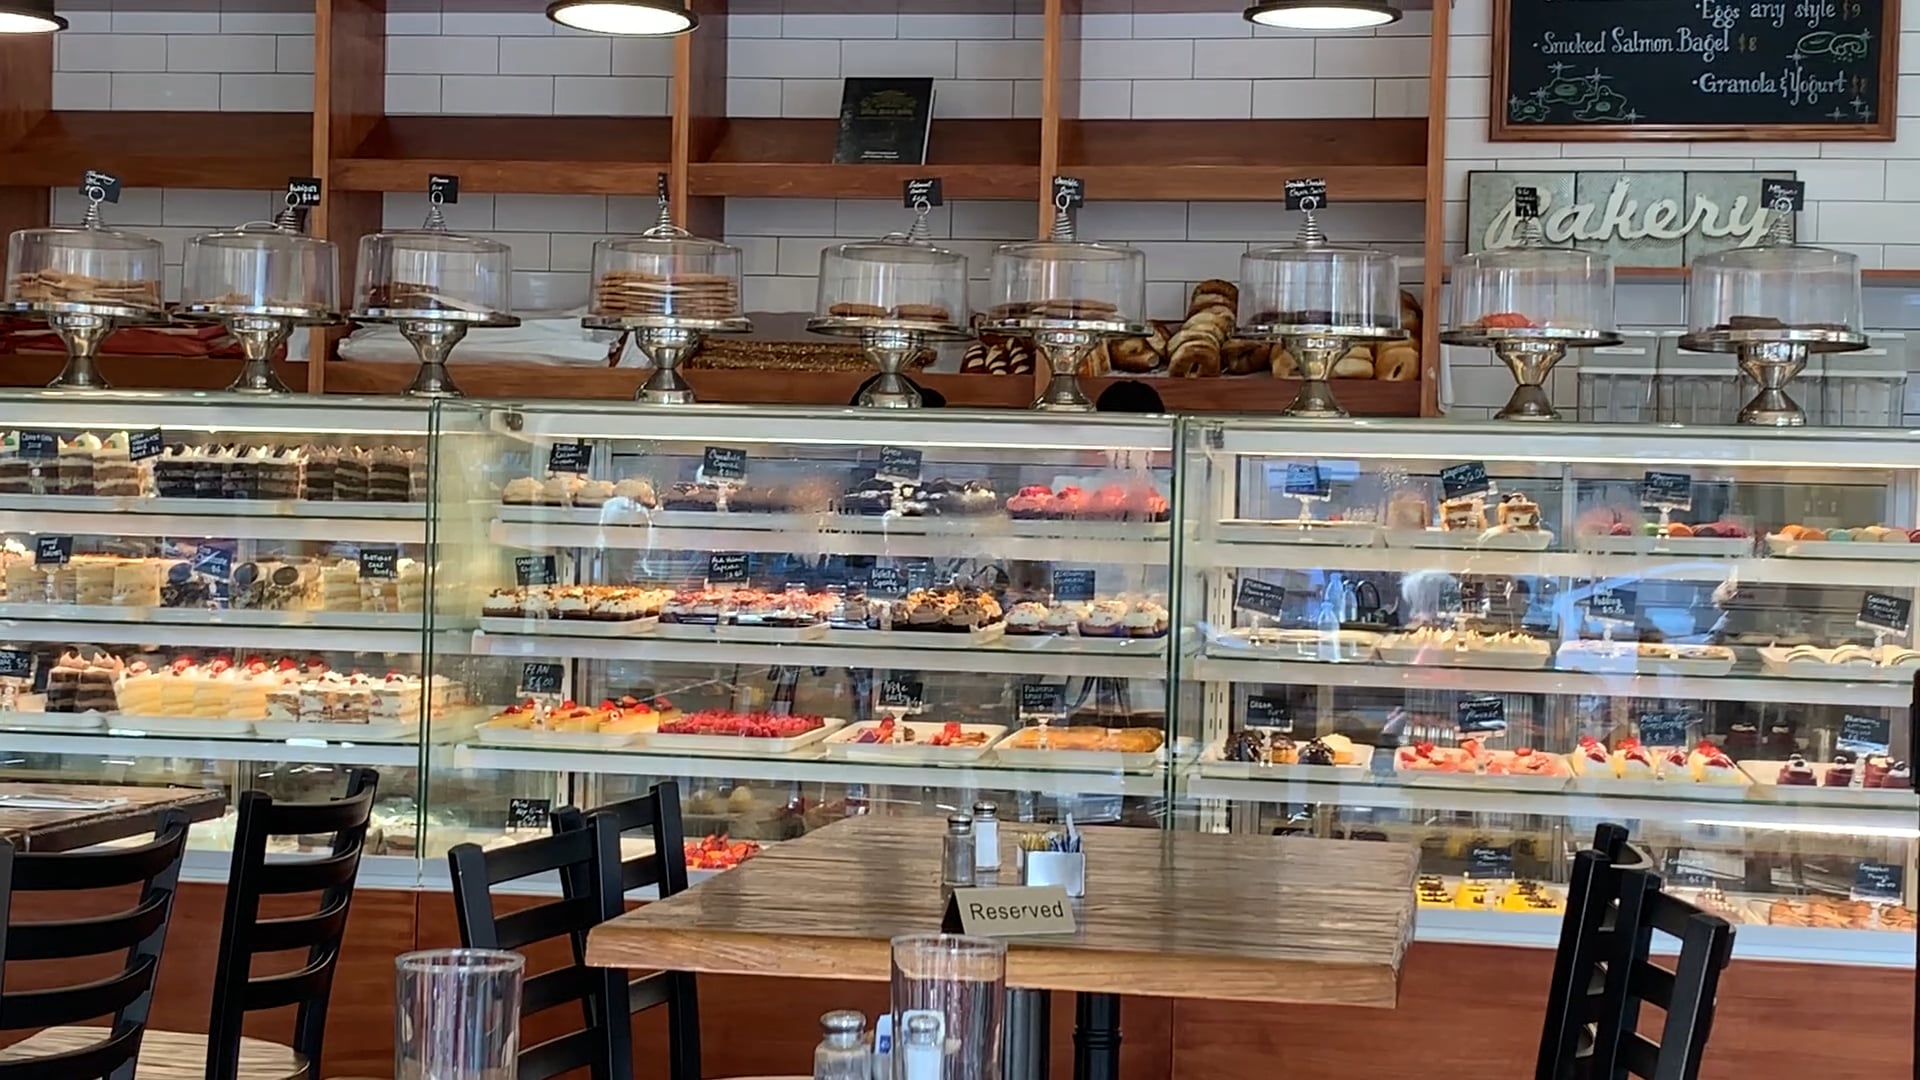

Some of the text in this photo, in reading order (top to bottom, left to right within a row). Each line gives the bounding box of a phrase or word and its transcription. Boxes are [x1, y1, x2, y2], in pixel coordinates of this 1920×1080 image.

[1702, 0, 1740, 29] Eggs
[1750, 2, 1785, 28] any
[1794, 0, 1836, 28] style
[1541, 30, 1606, 54] Smoked
[1611, 26, 1673, 54] Salmon
[1676, 26, 1730, 63] Bagel
[1700, 71, 1777, 94] Granola
[969, 900, 1064, 920] Reserved
